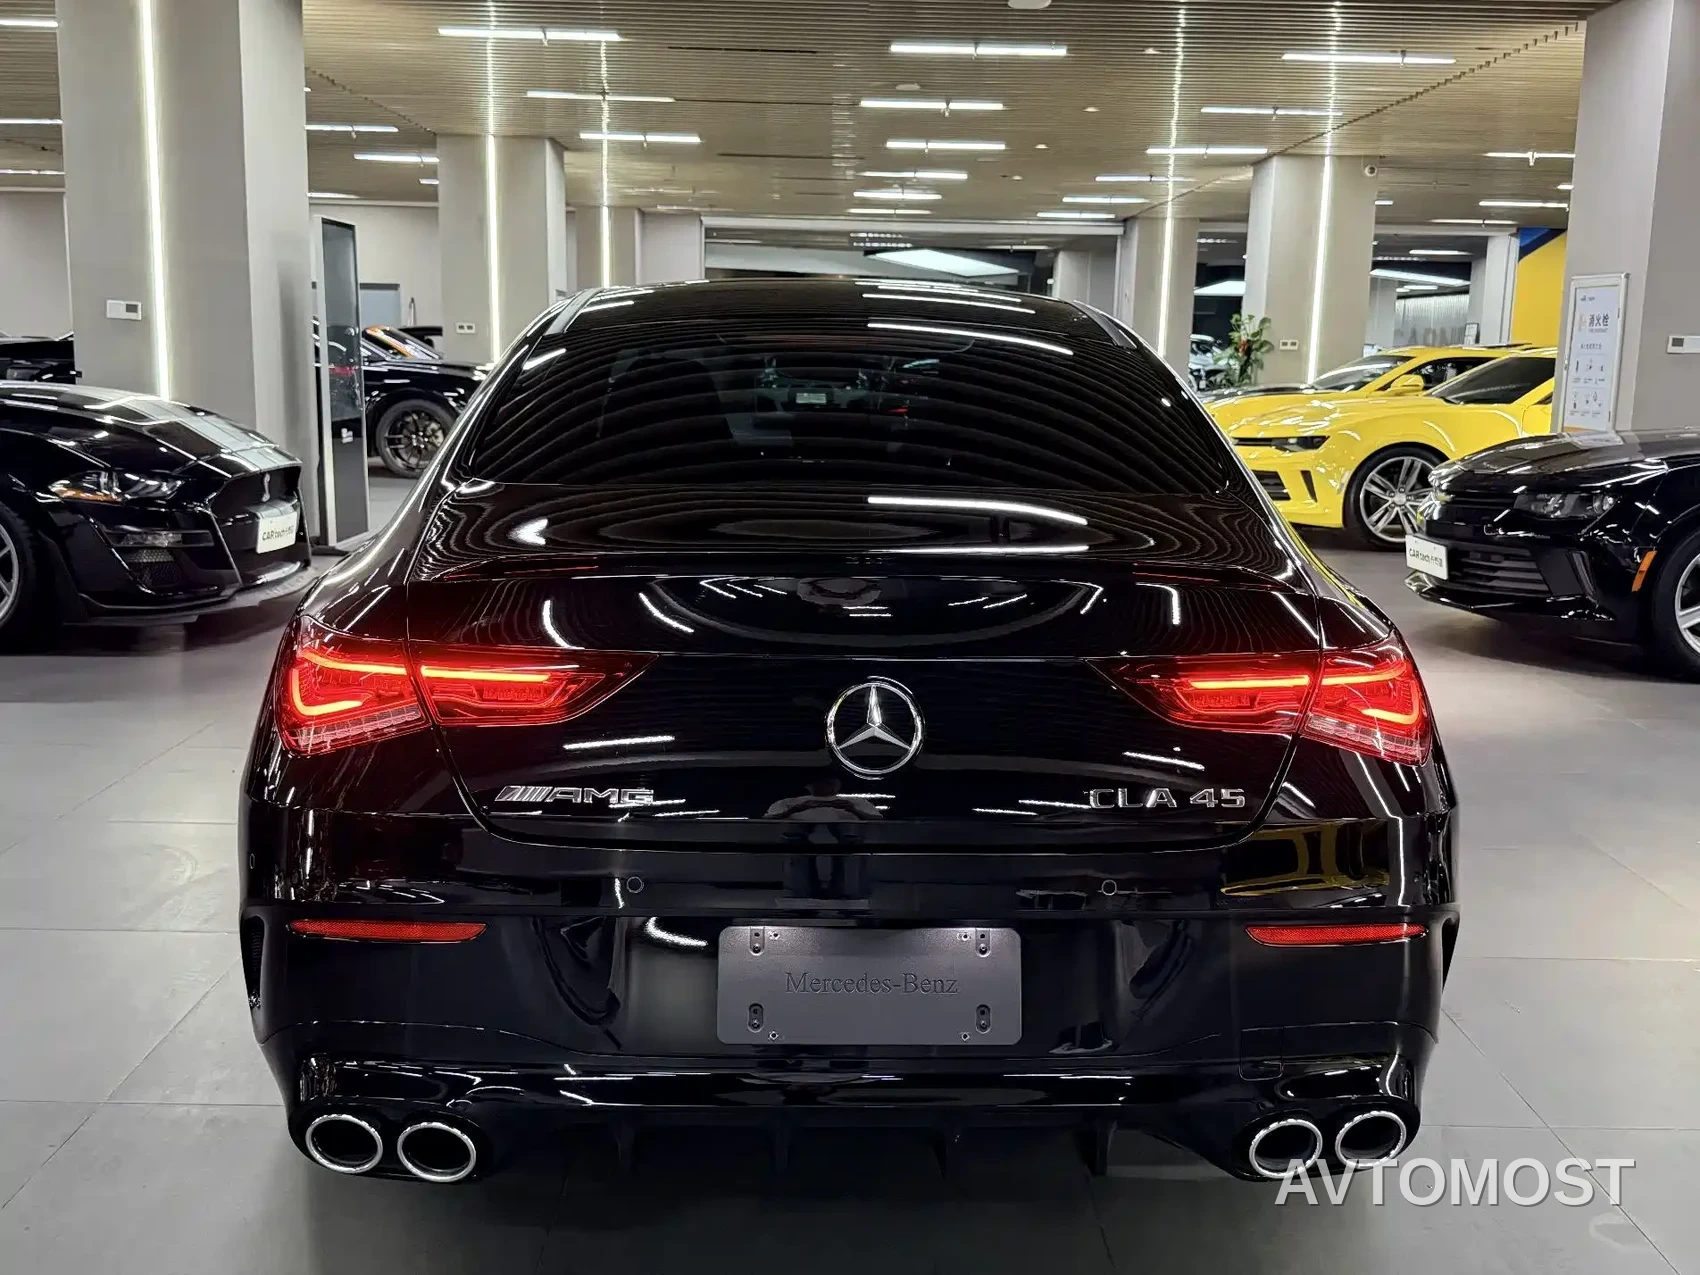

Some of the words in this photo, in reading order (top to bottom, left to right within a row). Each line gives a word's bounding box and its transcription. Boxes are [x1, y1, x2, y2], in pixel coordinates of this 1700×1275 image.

[544, 786, 655, 804] AMG
[1088, 787, 1178, 809] CLA
[1189, 787, 1247, 808] 45
[784, 971, 959, 995] Mercedes-Benz
